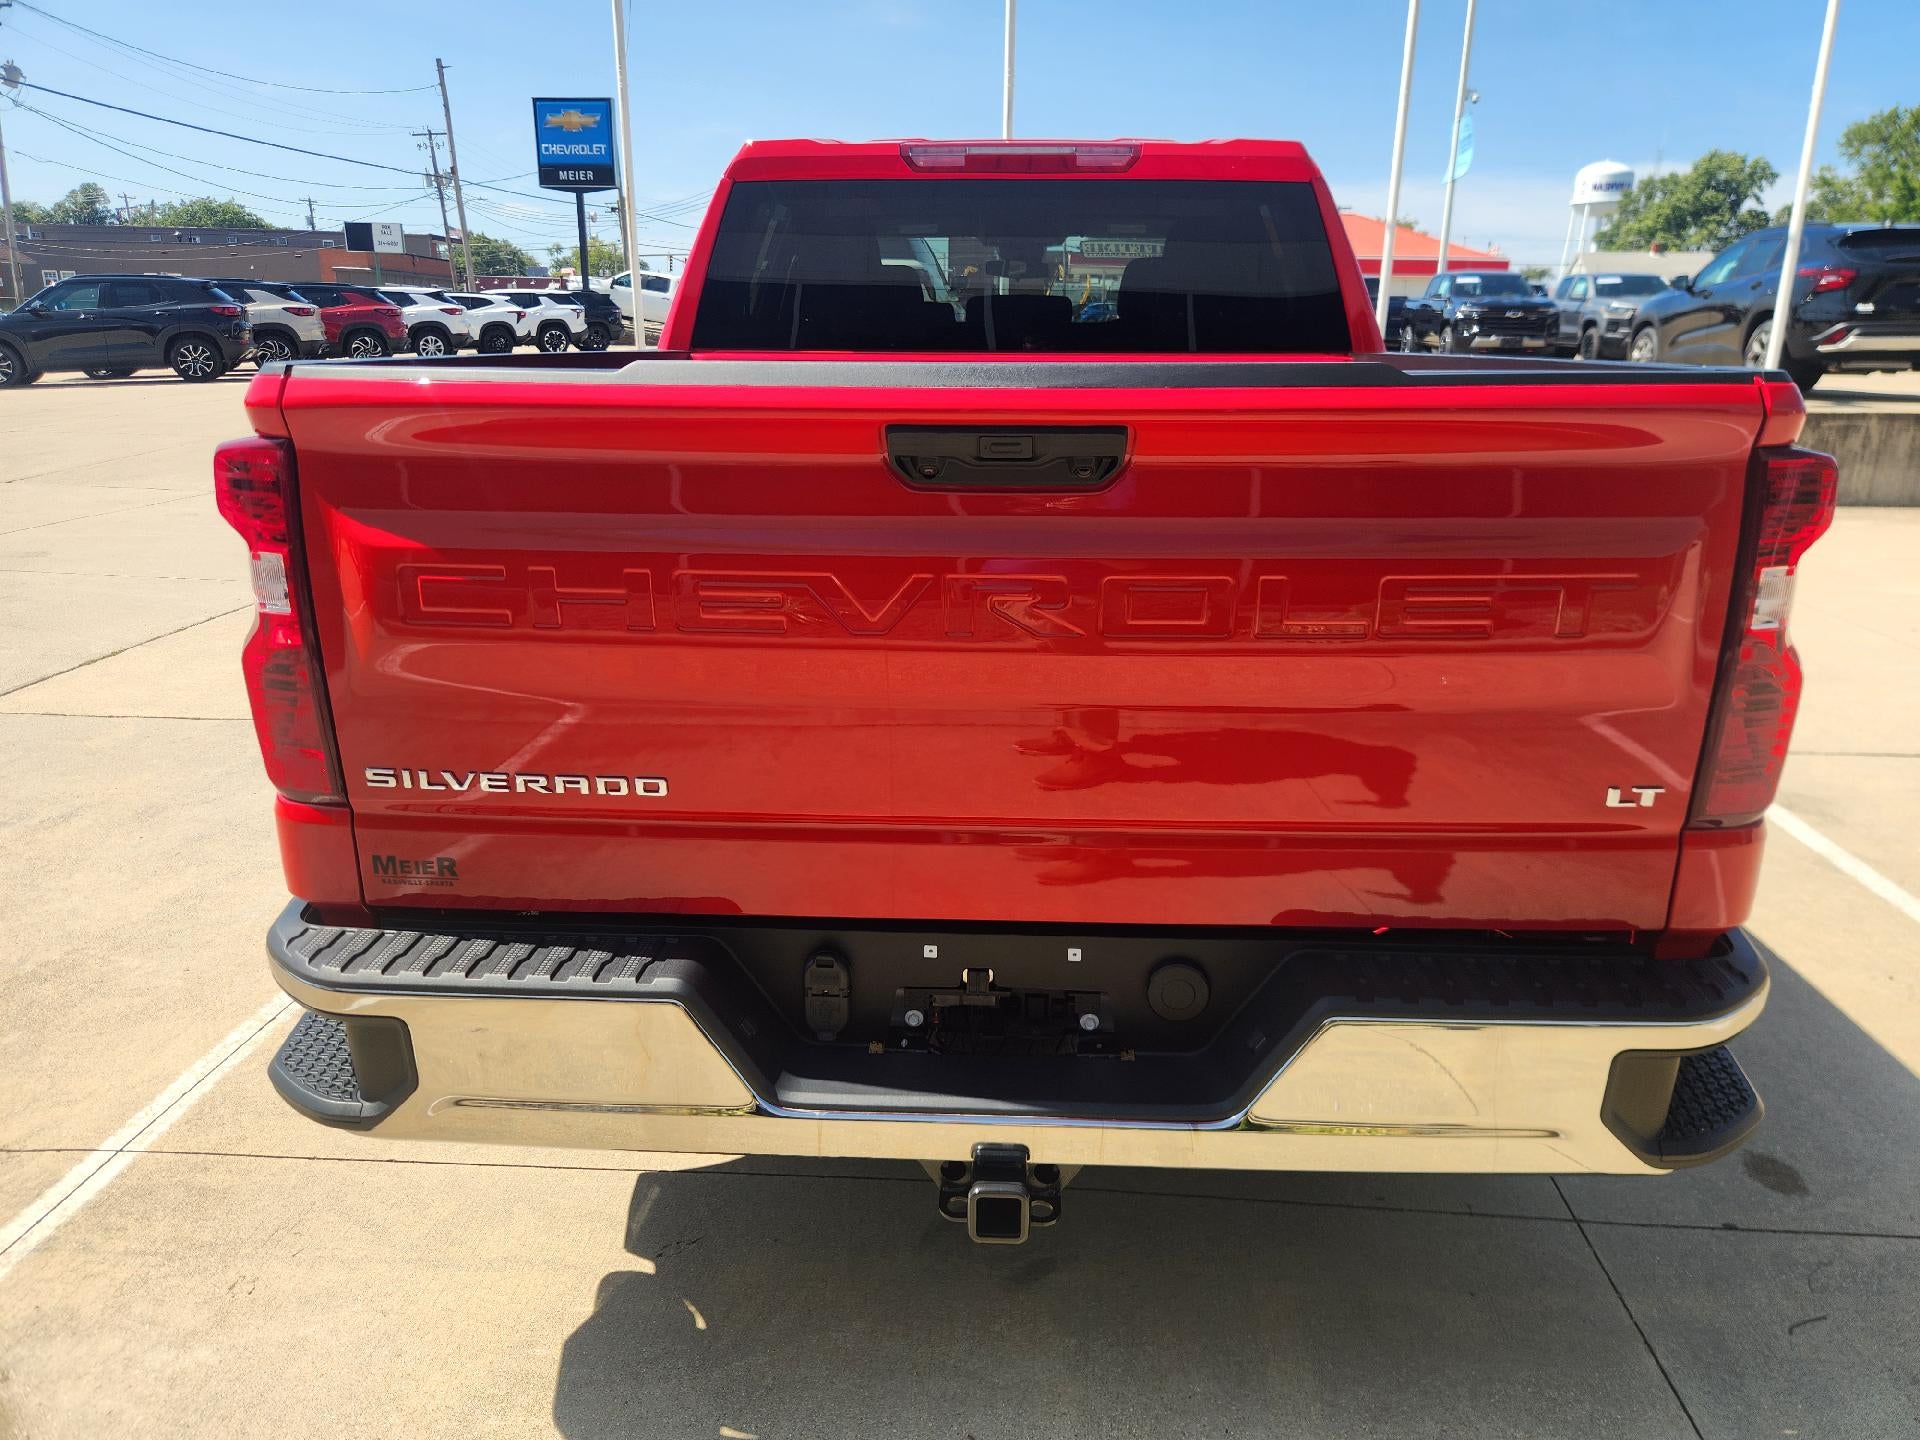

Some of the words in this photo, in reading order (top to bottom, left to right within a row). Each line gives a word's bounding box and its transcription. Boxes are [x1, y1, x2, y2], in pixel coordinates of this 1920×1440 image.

[541, 143, 607, 155] CHEVROLET
[559, 170, 594, 181] MEIER
[396, 562, 1641, 639] CHEVROLET
[364, 767, 670, 797] SILVERADO
[1605, 785, 1666, 808] LT
